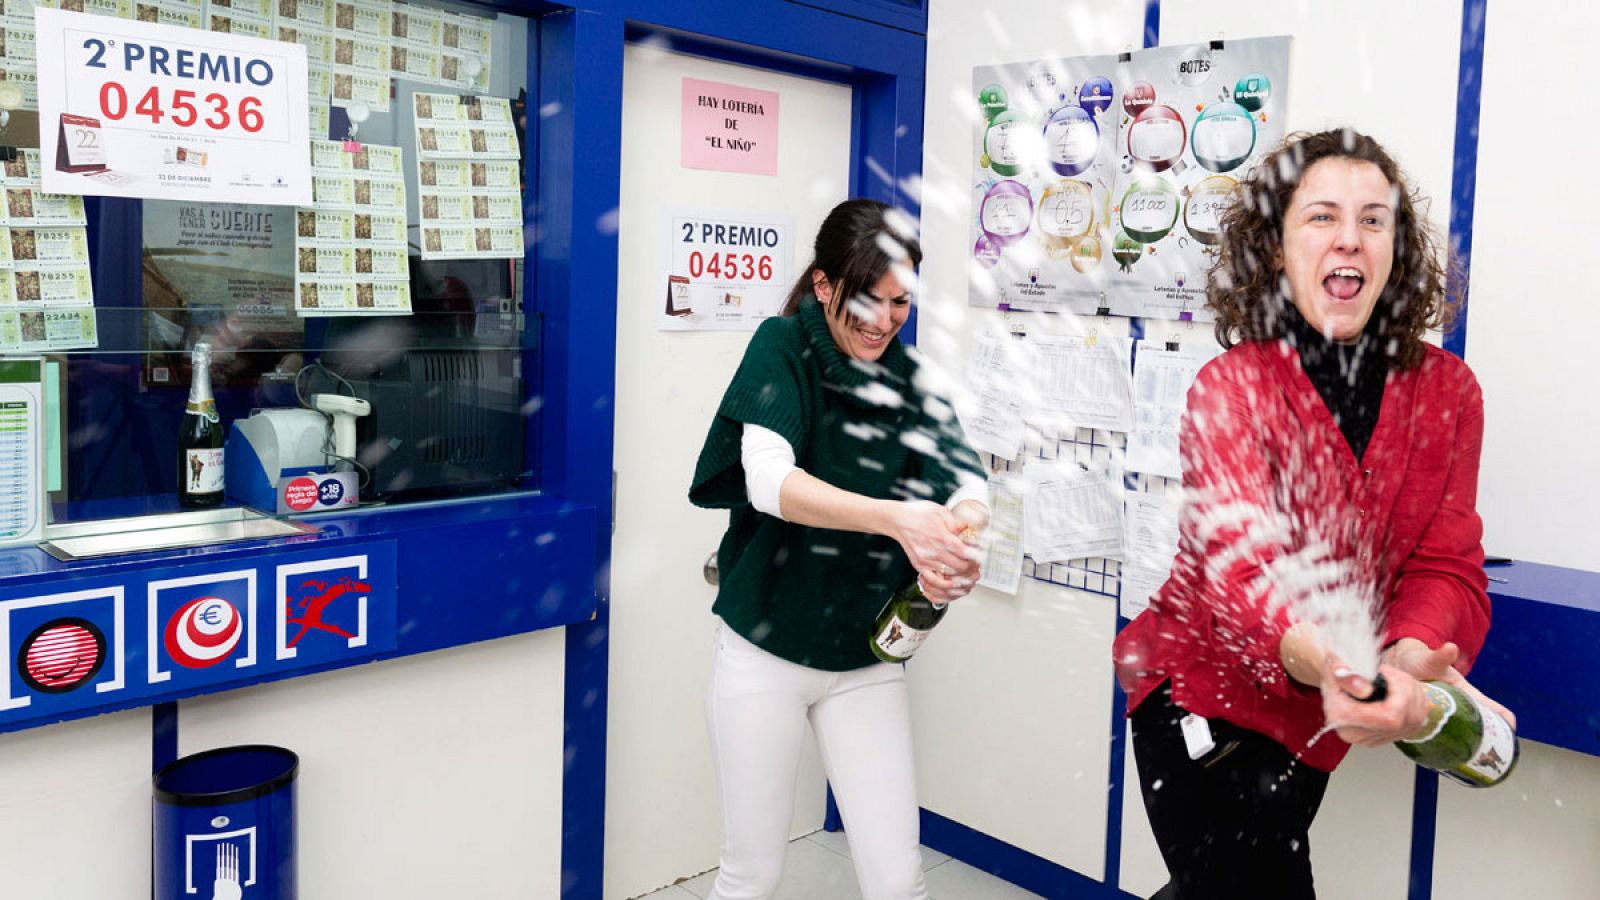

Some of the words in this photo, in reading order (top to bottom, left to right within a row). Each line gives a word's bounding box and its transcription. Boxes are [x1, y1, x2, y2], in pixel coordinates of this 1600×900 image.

[123, 42, 274, 86] PREMIO
[1179, 59, 1212, 74] BOTES
[99, 80, 265, 133] 04536
[698, 95, 719, 109] HAY
[722, 97, 765, 116] LOTERÍA
[725, 118, 738, 131] DE
[179, 207, 196, 217] VAS
[199, 208, 206, 218] A
[179, 217, 206, 229] TENER
[211, 209, 273, 233] SUERTE
[702, 223, 779, 248] PREMIO
[688, 250, 773, 281] 04536
[288, 485, 316, 493] Primera
[320, 483, 340, 493] +18
[287, 492, 304, 500] regla
